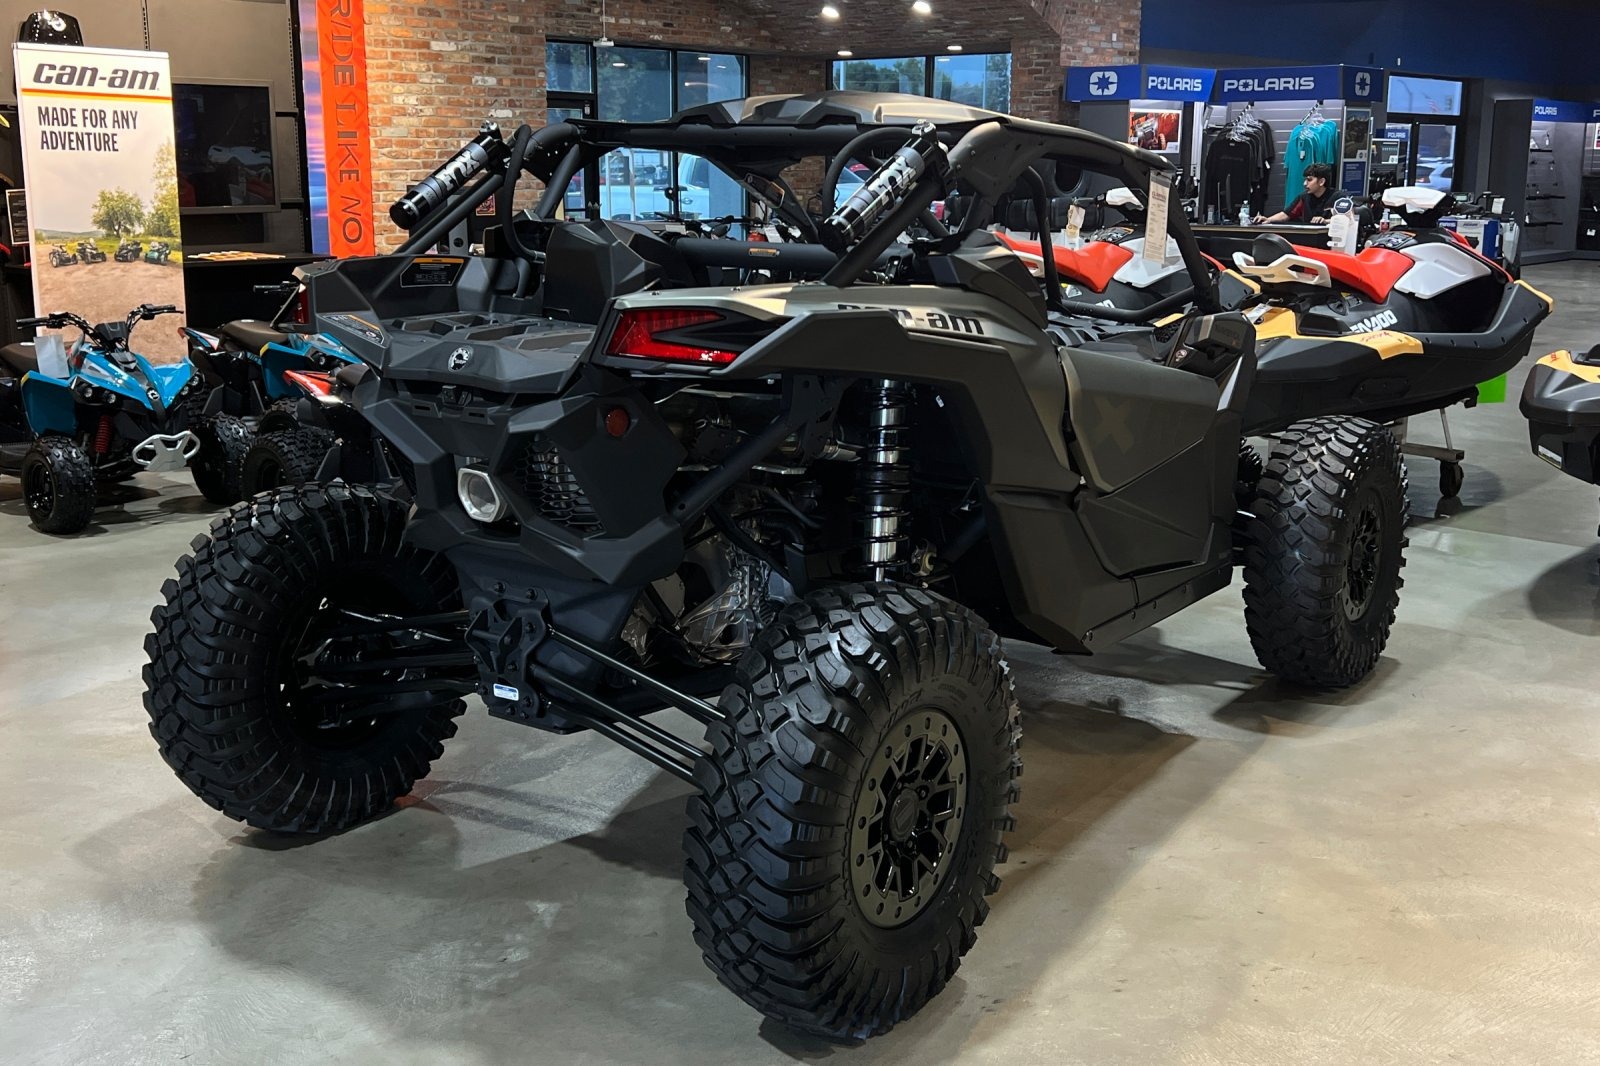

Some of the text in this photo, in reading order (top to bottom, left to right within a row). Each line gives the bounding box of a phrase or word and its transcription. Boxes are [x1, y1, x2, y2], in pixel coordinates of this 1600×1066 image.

[33, 63, 160, 91] can-am
[1147, 76, 1202, 92] POLARIS
[1223, 76, 1315, 92] POLARIS
[37, 106, 138, 130] MADE FOR ANY
[1534, 105, 1558, 115] POLARIS
[40, 130, 119, 152] ADVENTURE
[335, 103, 361, 183] LIKE
[435, 150, 481, 192] FOX
[867, 155, 918, 207] FOX
[340, 195, 362, 243] NO
